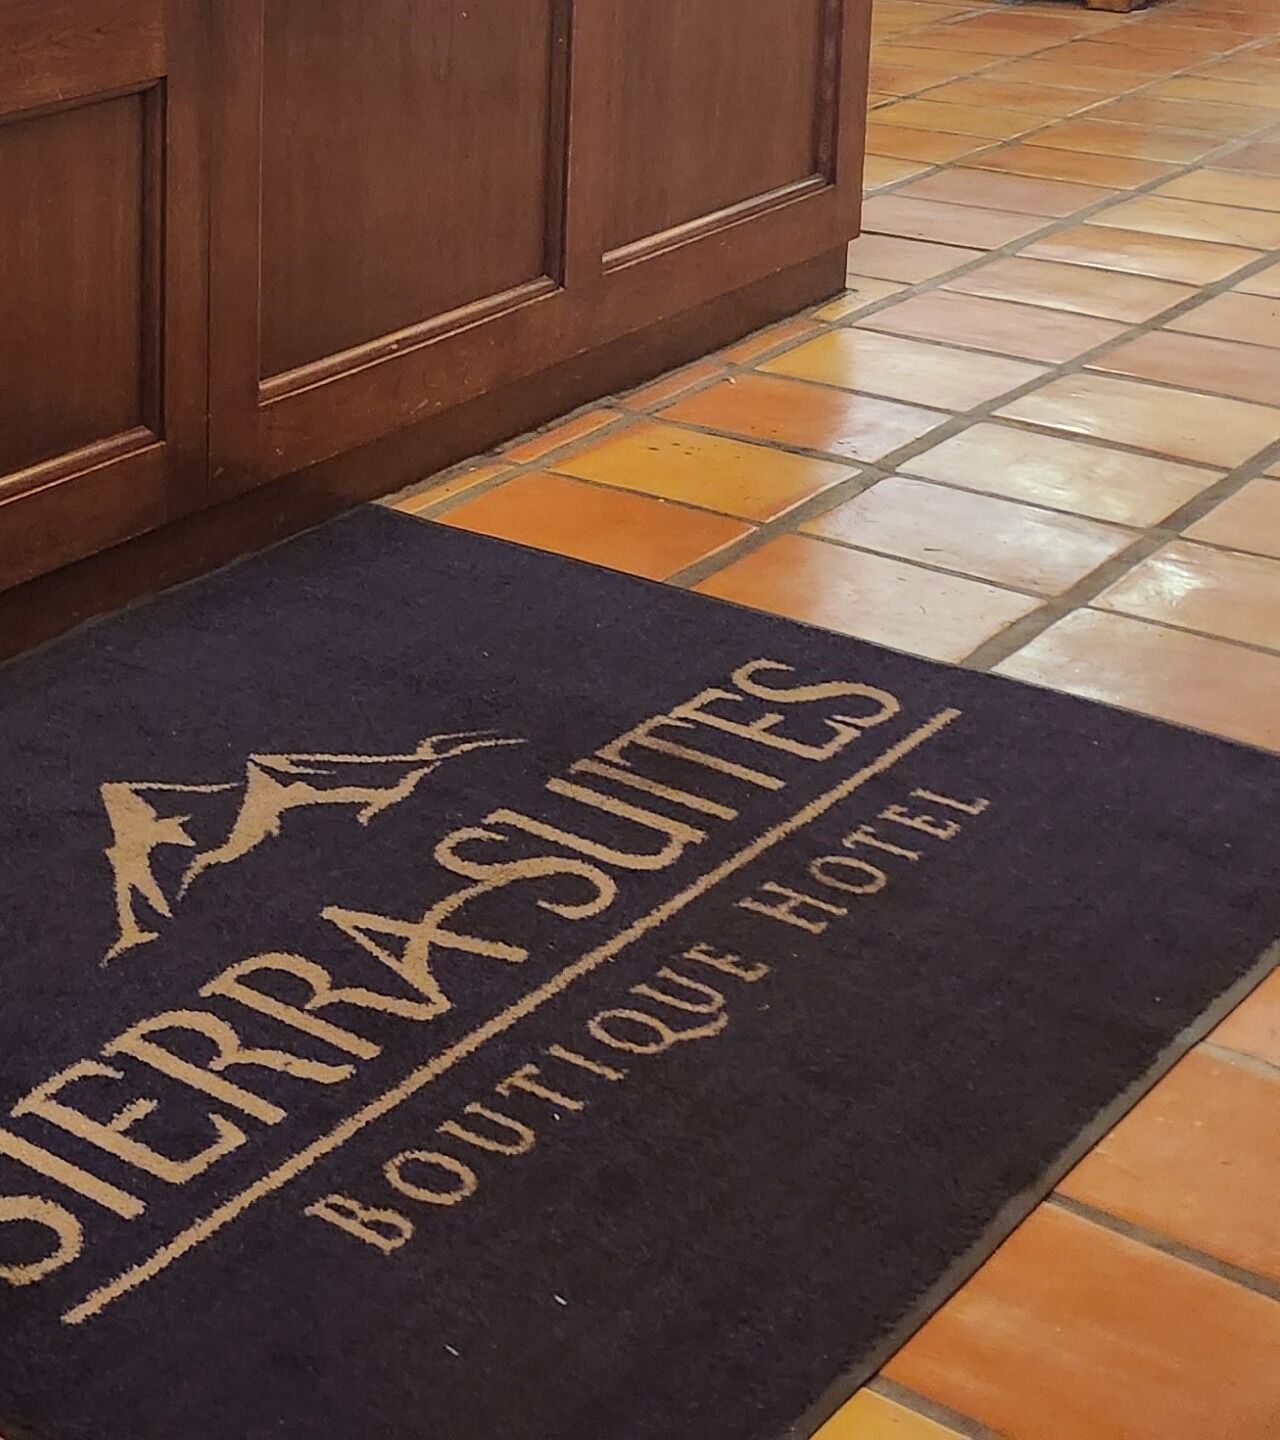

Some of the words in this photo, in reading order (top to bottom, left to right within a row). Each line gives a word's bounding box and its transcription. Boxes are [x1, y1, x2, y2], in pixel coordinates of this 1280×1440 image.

[437, 657, 902, 922] SUITES
[306, 940, 771, 1255] BOUTIQUE
[738, 784, 992, 936] HOTEL
